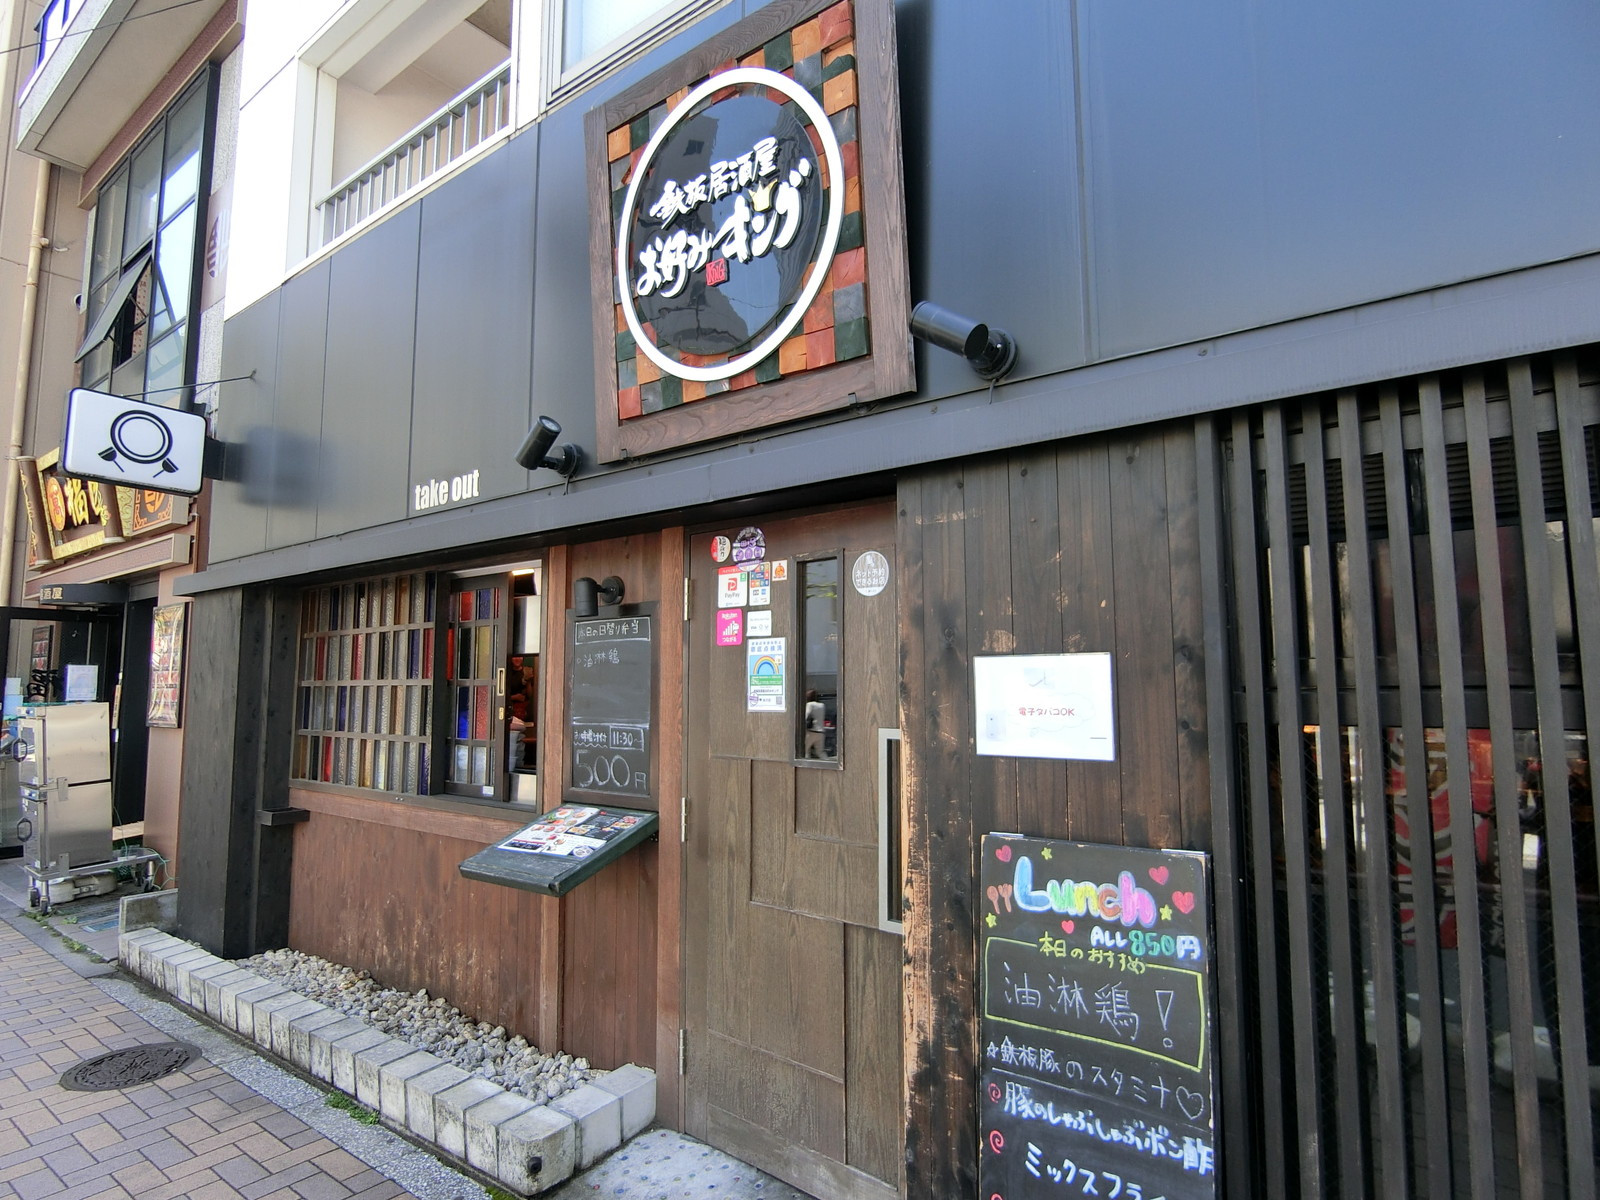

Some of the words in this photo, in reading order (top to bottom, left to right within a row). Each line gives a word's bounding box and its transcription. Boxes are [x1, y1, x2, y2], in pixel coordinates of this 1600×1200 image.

[649, 136, 780, 229] 鉄板居酒屋
[637, 157, 813, 298] お好みキング
[415, 479, 449, 511] take
[452, 469, 480, 502] out
[1018, 707, 1075, 717] 電子タバコOK
[576, 749, 646, 791] 500円
[1014, 856, 1157, 928] Lunch
[1038, 931, 1146, 975] 本日のおすすめ
[1090, 925, 1128, 948] ALL
[1128, 929, 1202, 961] 850円
[1025, 1141, 1167, 1200] ミックスフラ
